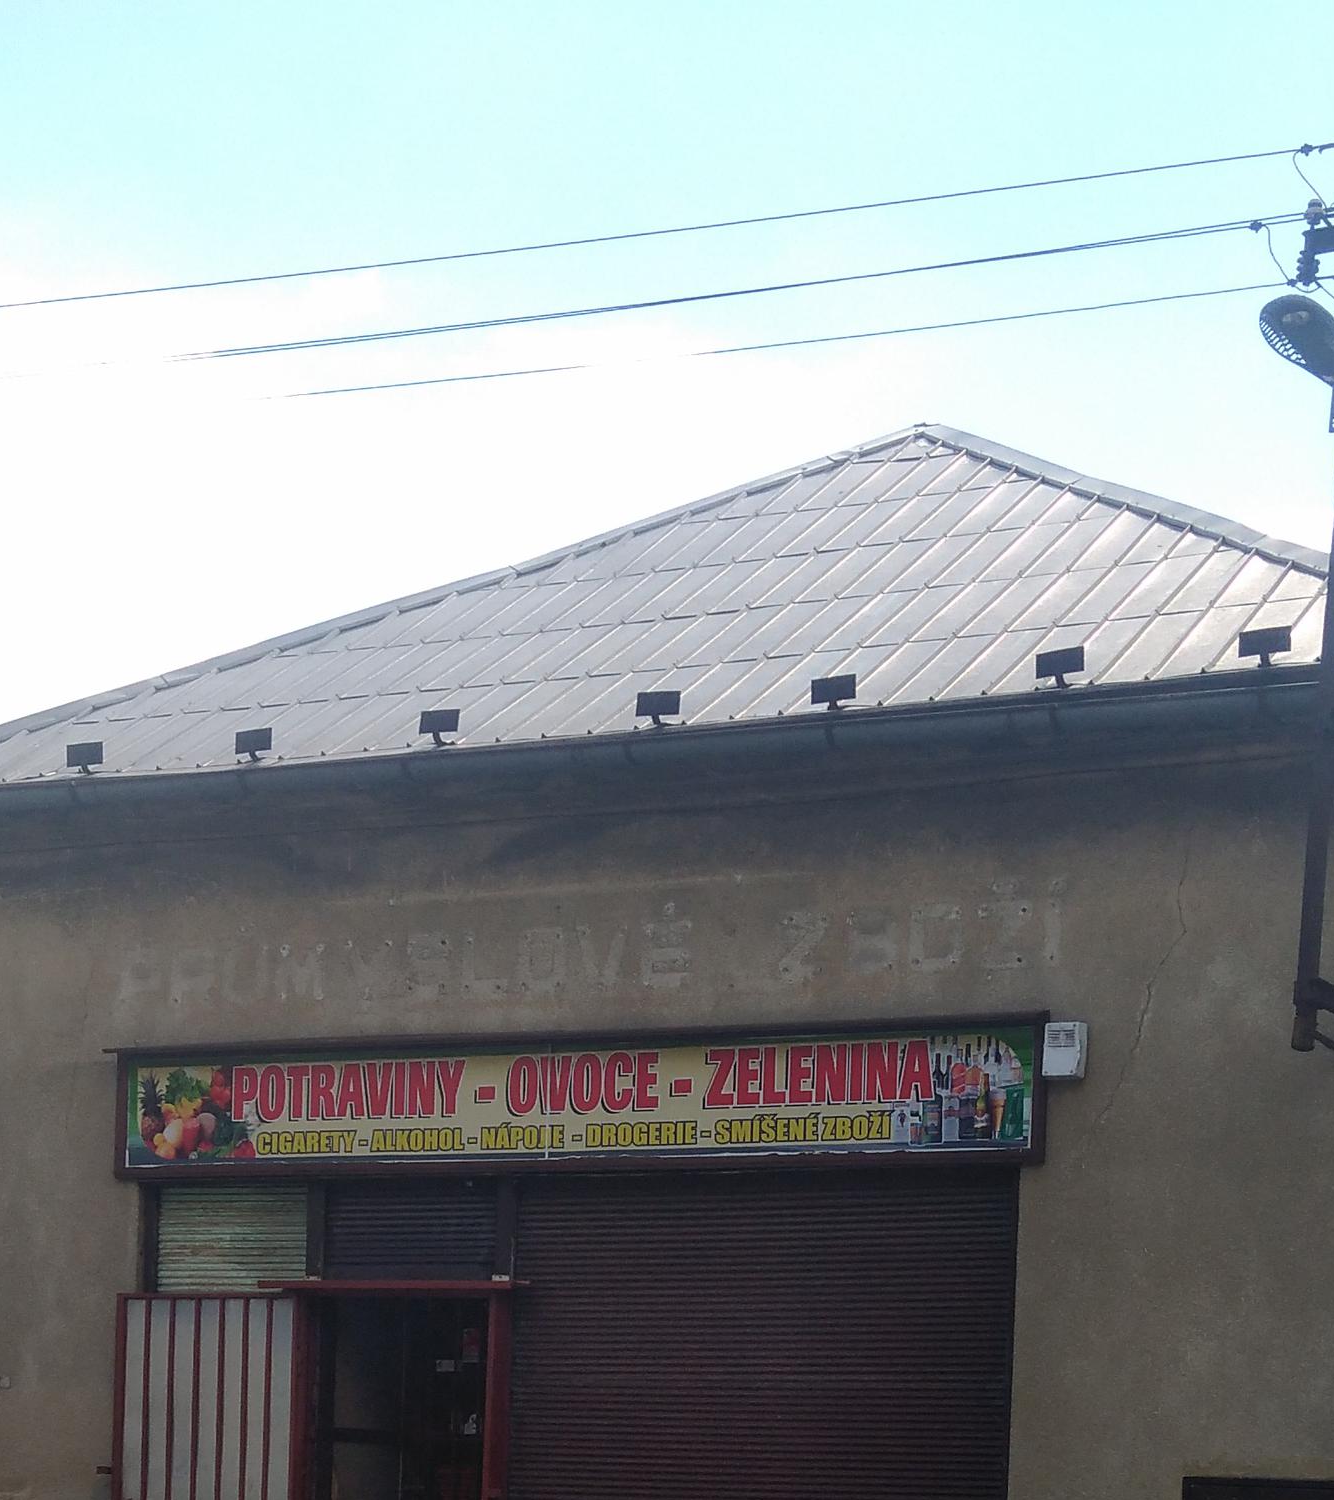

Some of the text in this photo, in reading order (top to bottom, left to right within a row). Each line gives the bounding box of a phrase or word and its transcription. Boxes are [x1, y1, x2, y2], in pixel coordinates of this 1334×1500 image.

[232, 1058, 466, 1122] POTRAVINY
[507, 1051, 660, 1116] OVOCE
[703, 1038, 935, 1109] ZELENINA
[255, 1127, 357, 1155] CIGARETY
[370, 1126, 465, 1153] ALKOHOL
[480, 1122, 565, 1150] NÁPOJE
[585, 1121, 698, 1148] DROGERIE
[715, 1112, 820, 1144] SMÍŠENÉ
[821, 1110, 893, 1140] ZBOŽÍ
